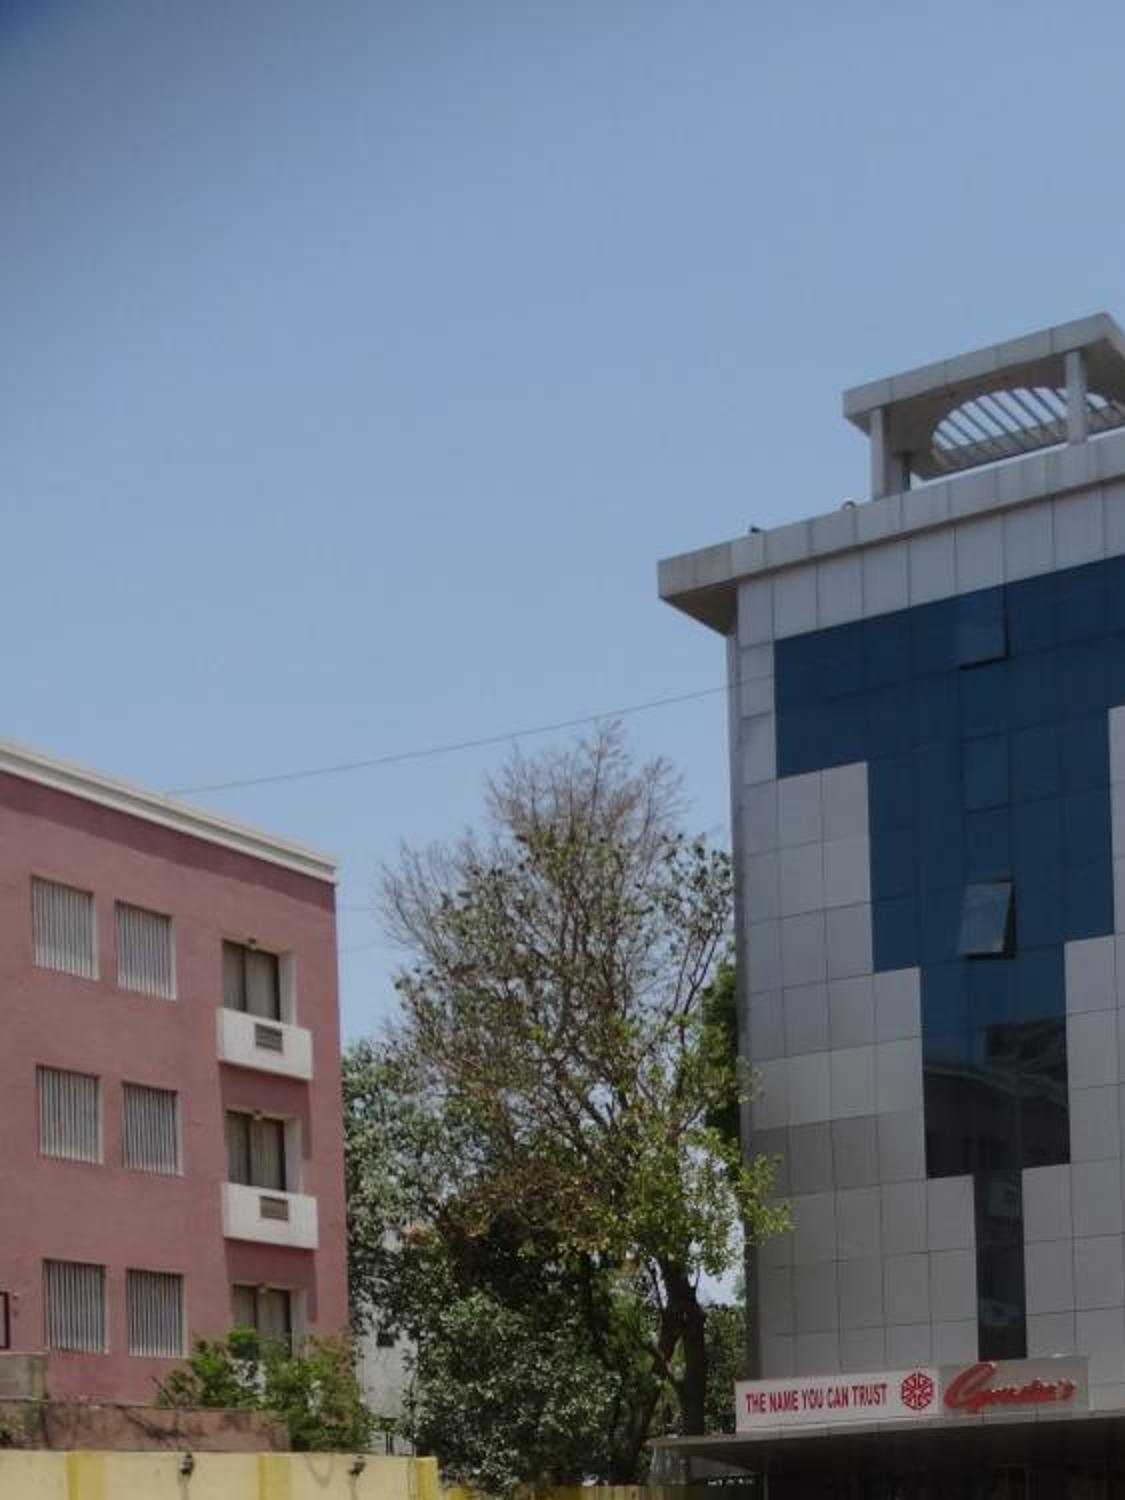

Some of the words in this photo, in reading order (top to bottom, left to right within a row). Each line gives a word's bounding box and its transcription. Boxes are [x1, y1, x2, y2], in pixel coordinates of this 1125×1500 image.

[745, 1393, 767, 1414] THE
[769, 1390, 799, 1412] NAME
[801, 1387, 823, 1410] YOU
[827, 1386, 849, 1408] CAN
[851, 1383, 888, 1407] TRUST
